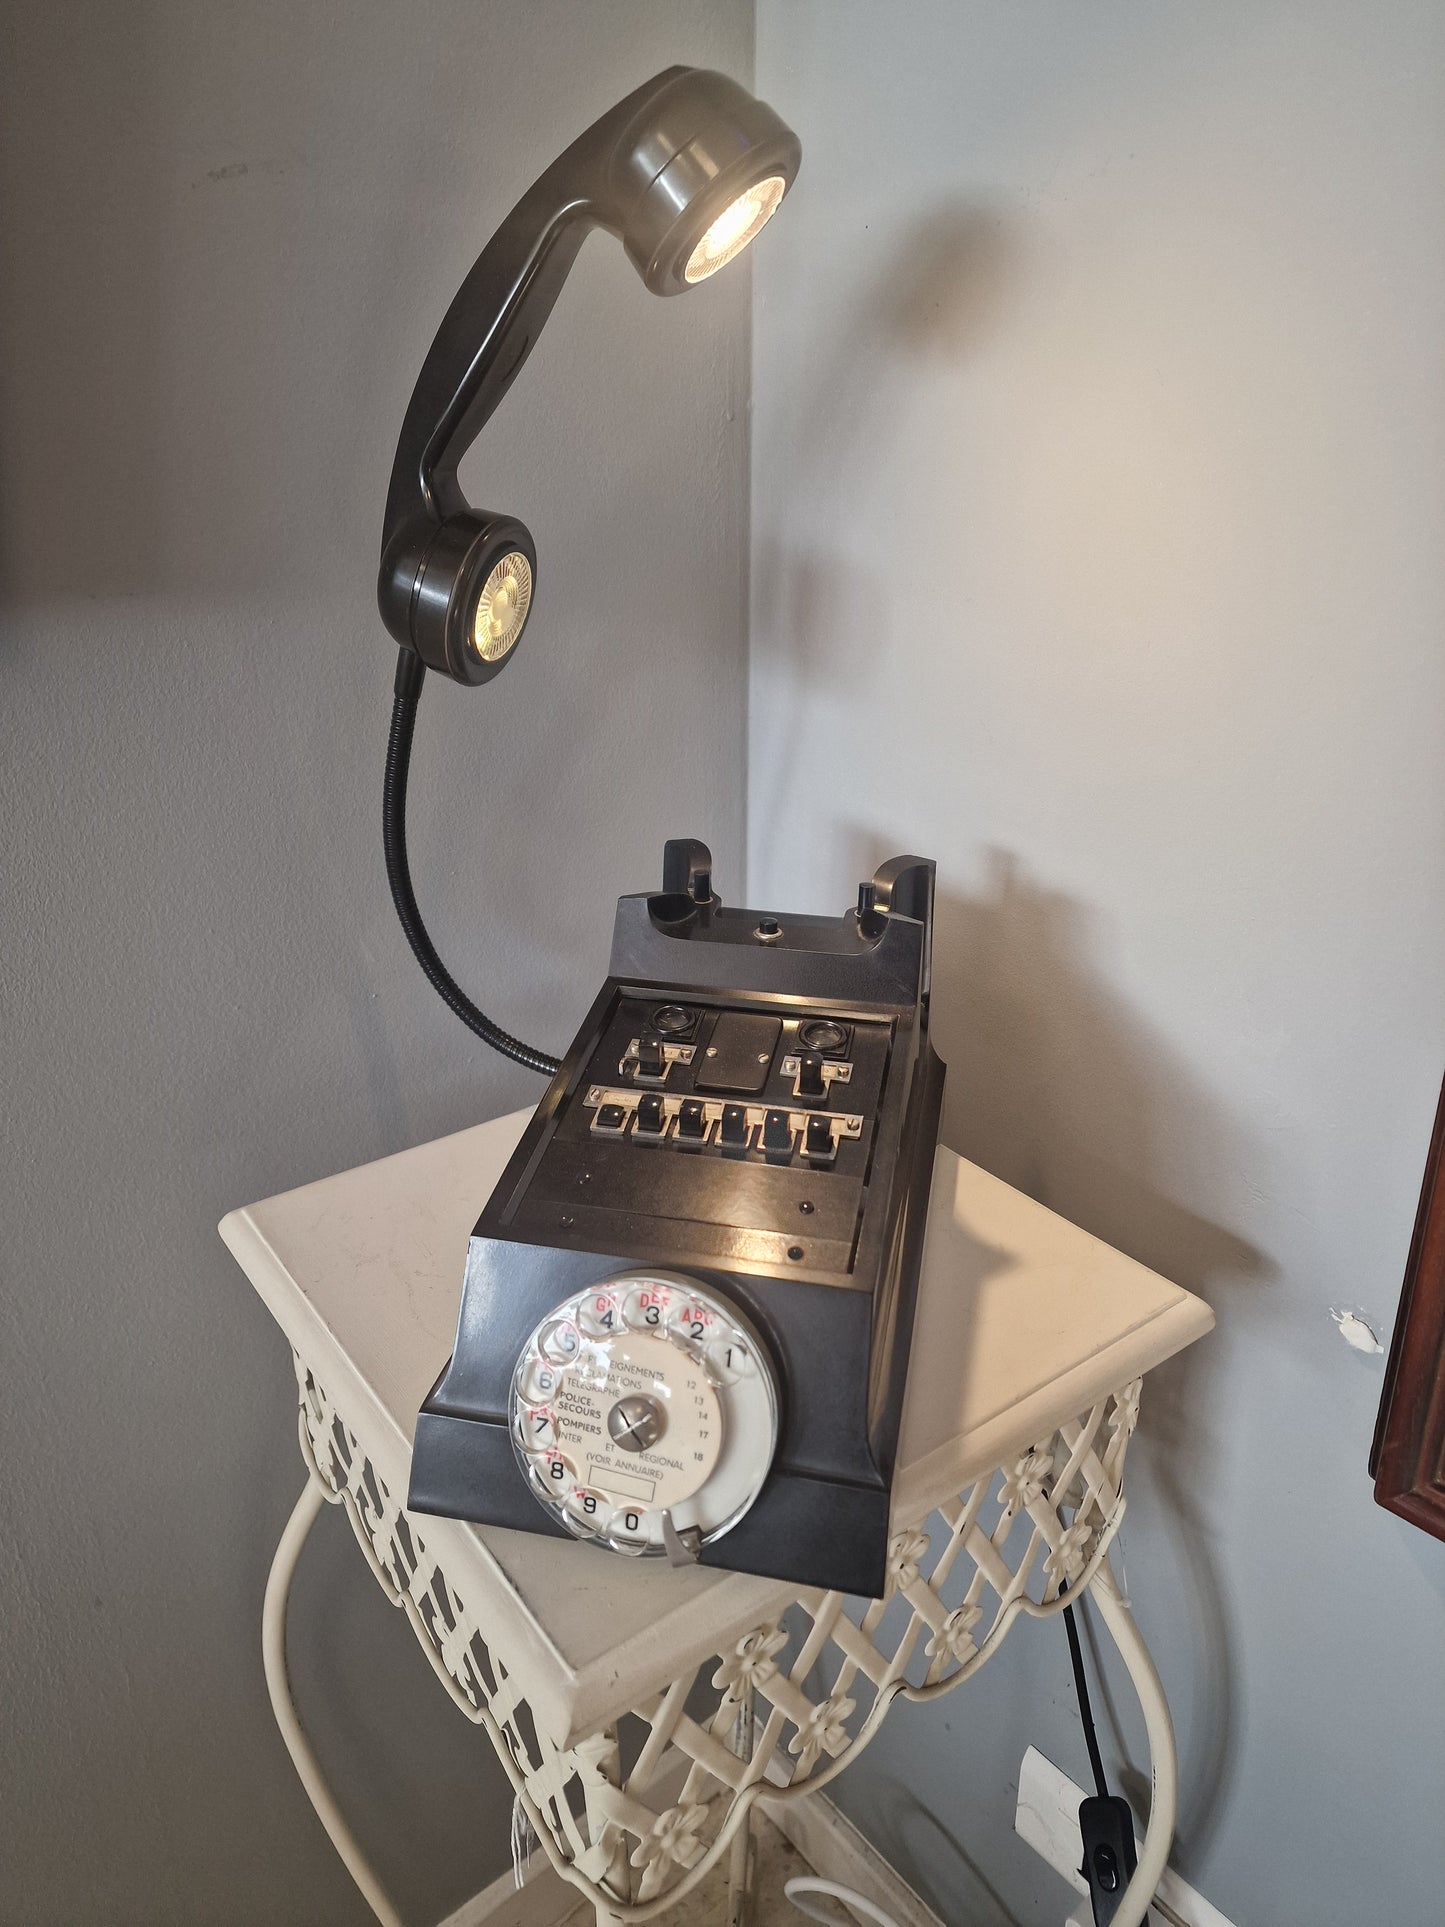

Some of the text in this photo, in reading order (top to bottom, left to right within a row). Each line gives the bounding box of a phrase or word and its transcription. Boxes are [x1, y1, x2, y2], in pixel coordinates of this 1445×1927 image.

[599, 1310, 613, 1329] 4
[645, 1306, 660, 1325] 3
[690, 1322, 704, 1340] 2
[564, 1333, 576, 1352] 5
[725, 1348, 732, 1368] 1
[588, 1354, 665, 1382] REIGNEMENTS
[539, 1371, 552, 1390] 6
[687, 1381, 697, 1389] 12
[560, 1391, 595, 1407] POLICE-
[695, 1396, 704, 1406] 13
[558, 1401, 602, 1419] SECOURS
[699, 1411, 708, 1420] 14
[535, 1416, 549, 1433] 7
[557, 1416, 602, 1435] POMPIERS
[700, 1430, 709, 1439] 17
[605, 1443, 615, 1452] ET
[639, 1452, 684, 1471] REGIONAL
[694, 1452, 704, 1462] 18
[551, 1461, 564, 1480] 8
[586, 1453, 664, 1480] (VOIR ANNUAIRE)
[583, 1497, 597, 1514] 9
